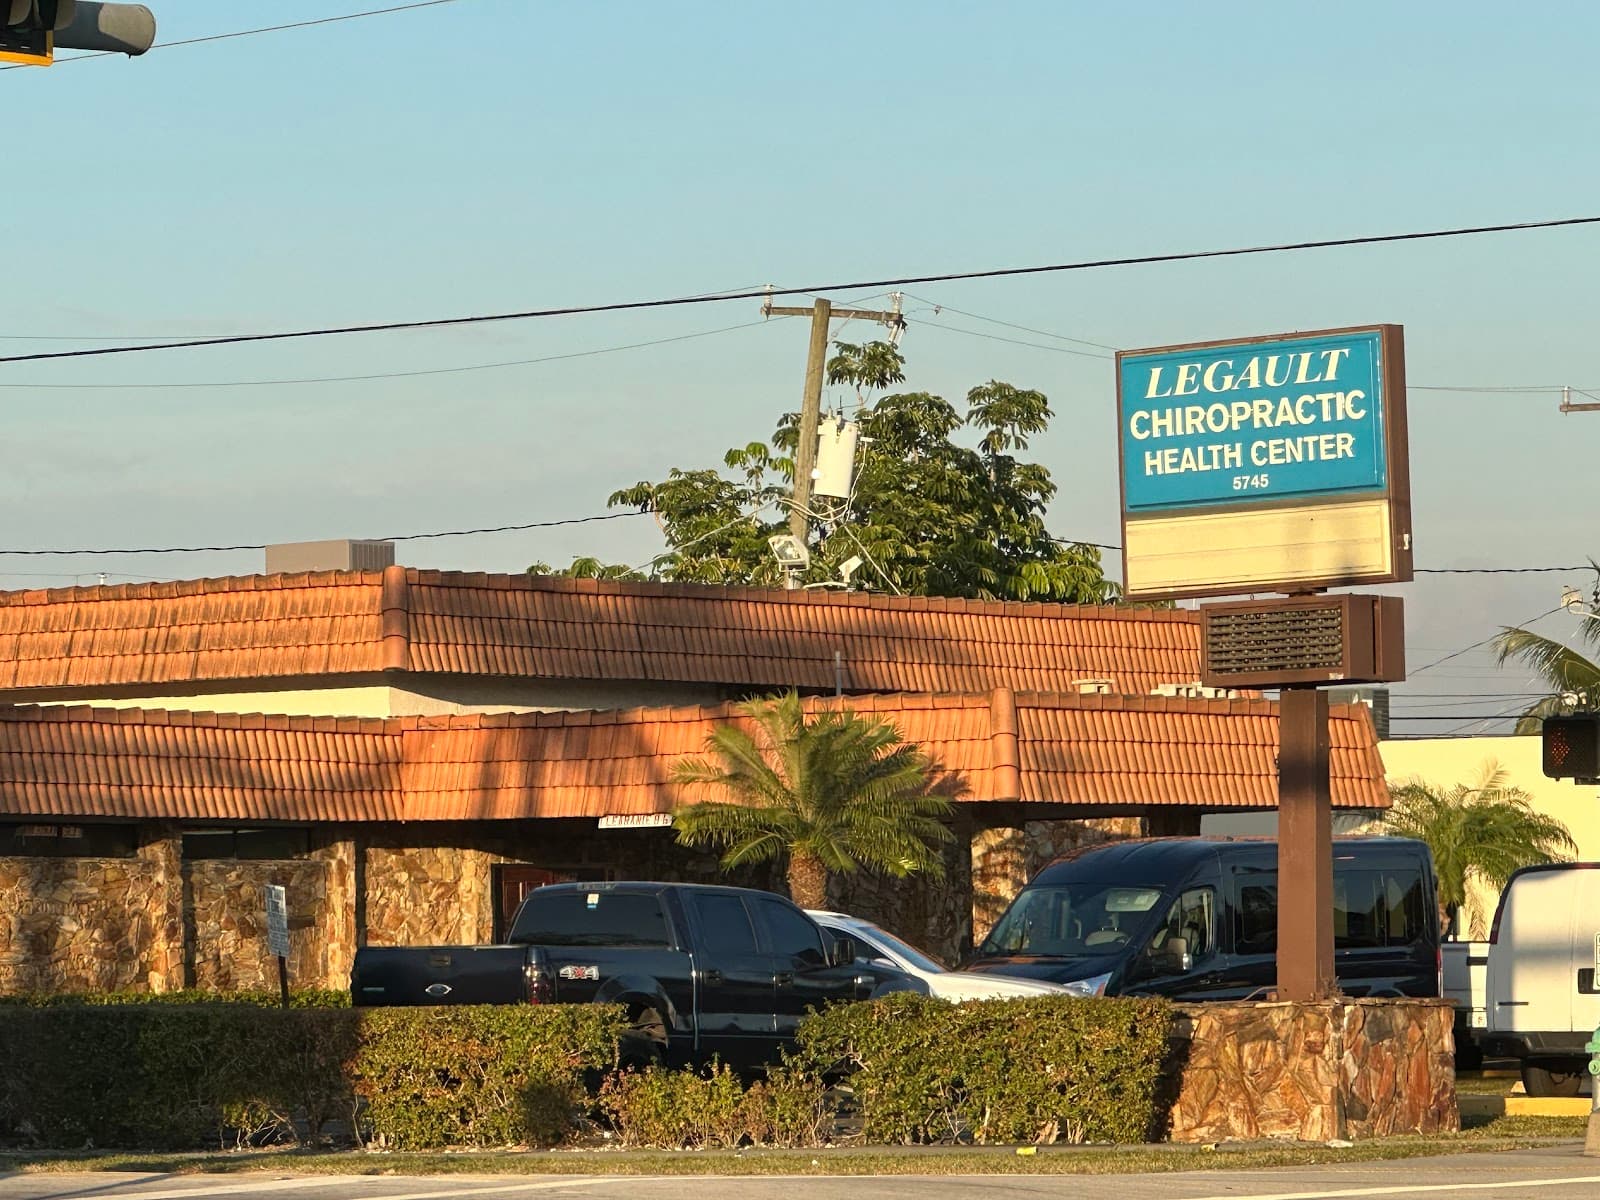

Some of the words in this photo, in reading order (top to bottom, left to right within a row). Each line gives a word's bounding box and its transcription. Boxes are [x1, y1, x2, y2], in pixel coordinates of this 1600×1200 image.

[1144, 348, 1350, 399] LEGAULT
[1130, 389, 1367, 440] CHIROPRACTIC
[1144, 442, 1243, 476] HEALTH
[1250, 432, 1355, 467] CENTER
[1232, 473, 1270, 491] 5745
